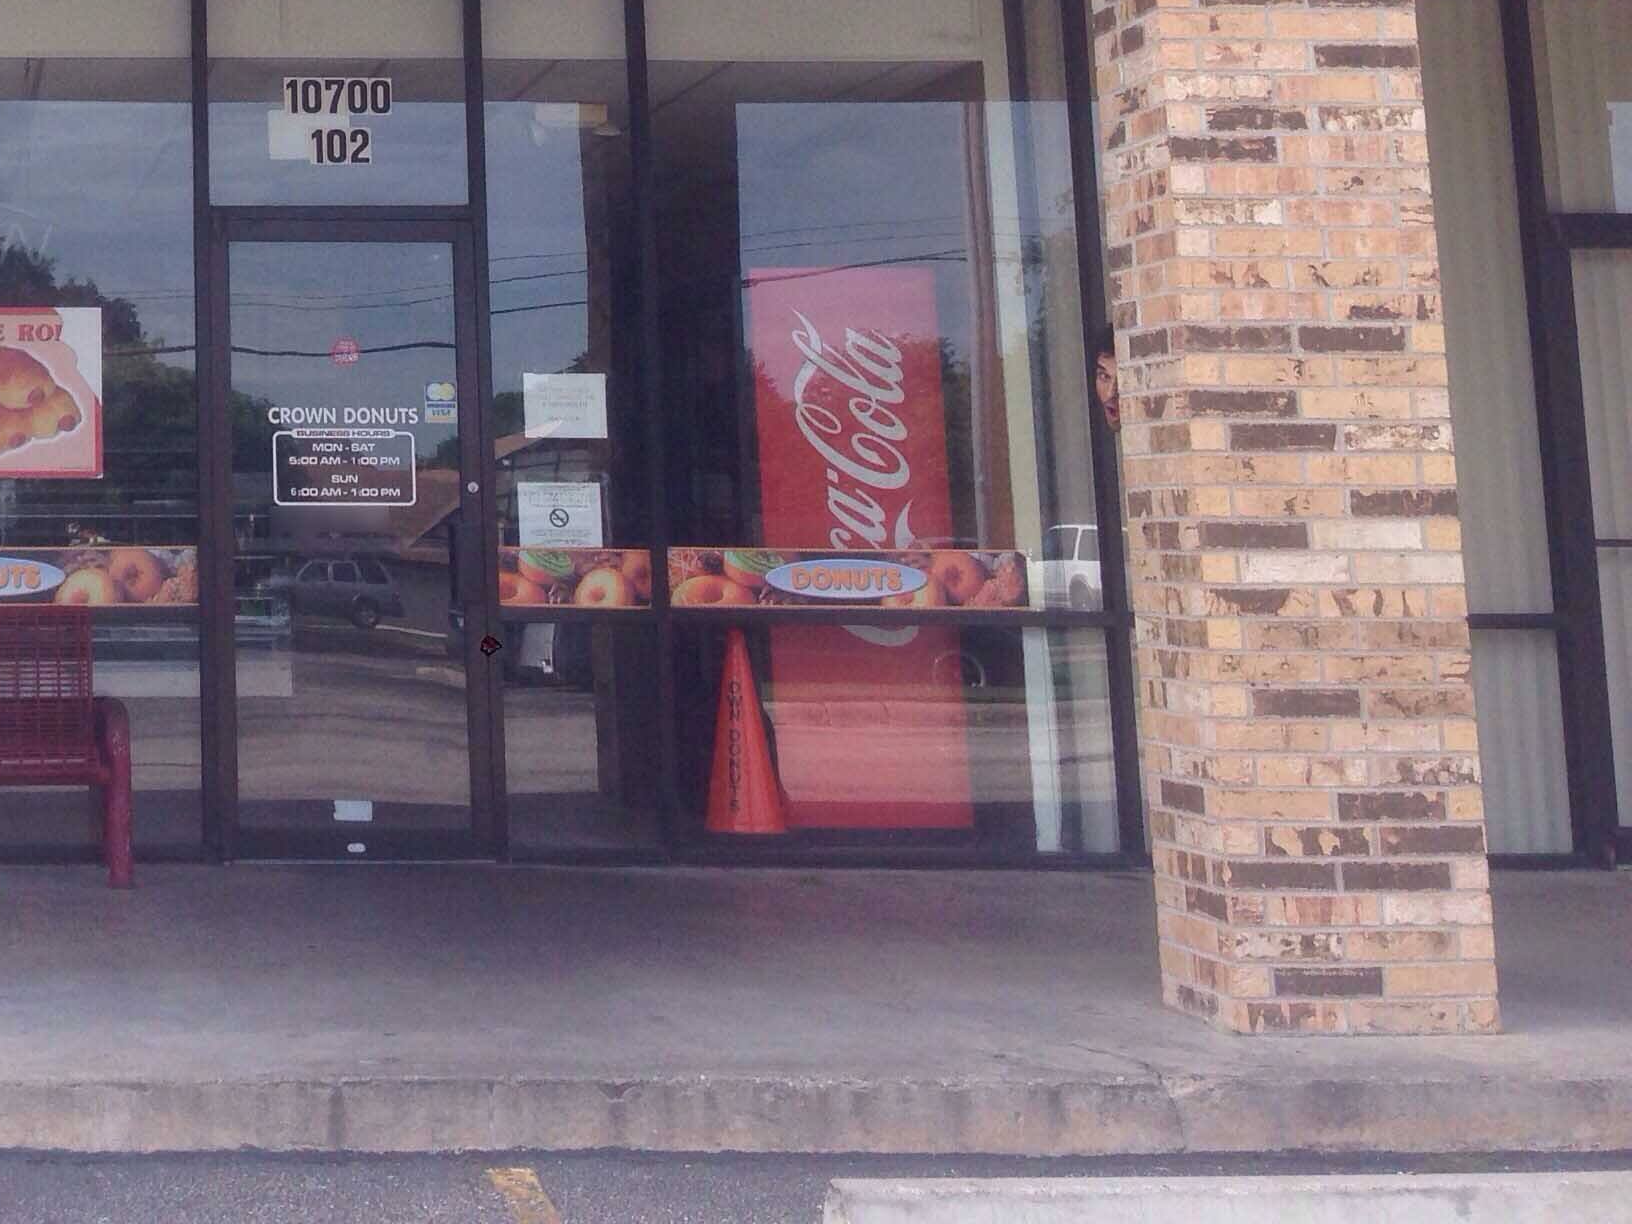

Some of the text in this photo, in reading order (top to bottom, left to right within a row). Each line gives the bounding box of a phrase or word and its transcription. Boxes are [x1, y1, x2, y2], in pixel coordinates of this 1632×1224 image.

[285, 79, 391, 114] 10700
[311, 128, 371, 164] 102
[268, 407, 418, 424] CROWN DONUTS
[296, 429, 390, 438] BUSINESS HOURS
[312, 443, 343, 452] MON
[351, 443, 375, 452] SAT
[289, 456, 318, 465] 5:00
[319, 456, 341, 465] AM
[352, 456, 378, 465] 1:00
[380, 456, 400, 465] PM
[331, 474, 358, 484] SUN
[290, 487, 318, 496] 6:00
[319, 487, 341, 496] AM
[351, 487, 378, 496] 1:00
[380, 487, 400, 496] PM
[791, 566, 903, 591] DONUTS
